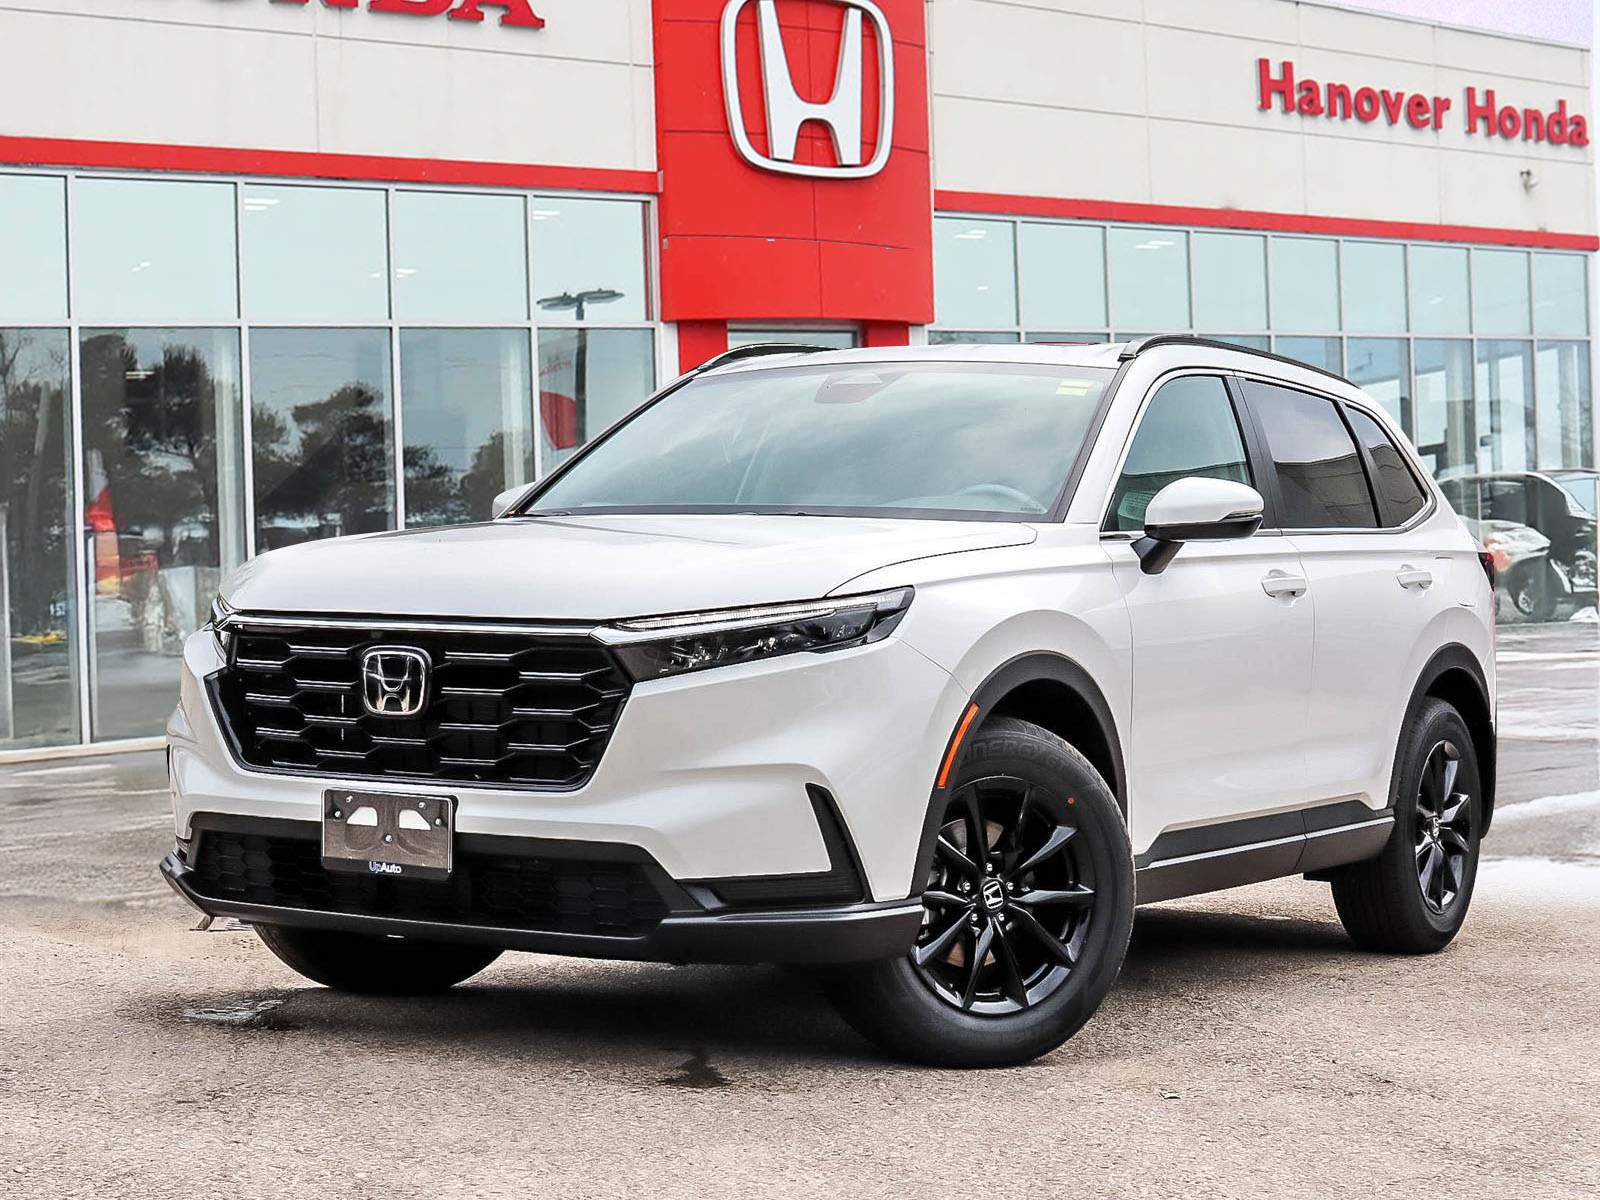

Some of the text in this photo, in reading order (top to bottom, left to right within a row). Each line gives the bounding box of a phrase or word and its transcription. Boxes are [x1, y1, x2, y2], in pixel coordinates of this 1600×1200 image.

[1257, 57, 1590, 147] Hanover Honda
[368, 861, 402, 874] UpAuto
